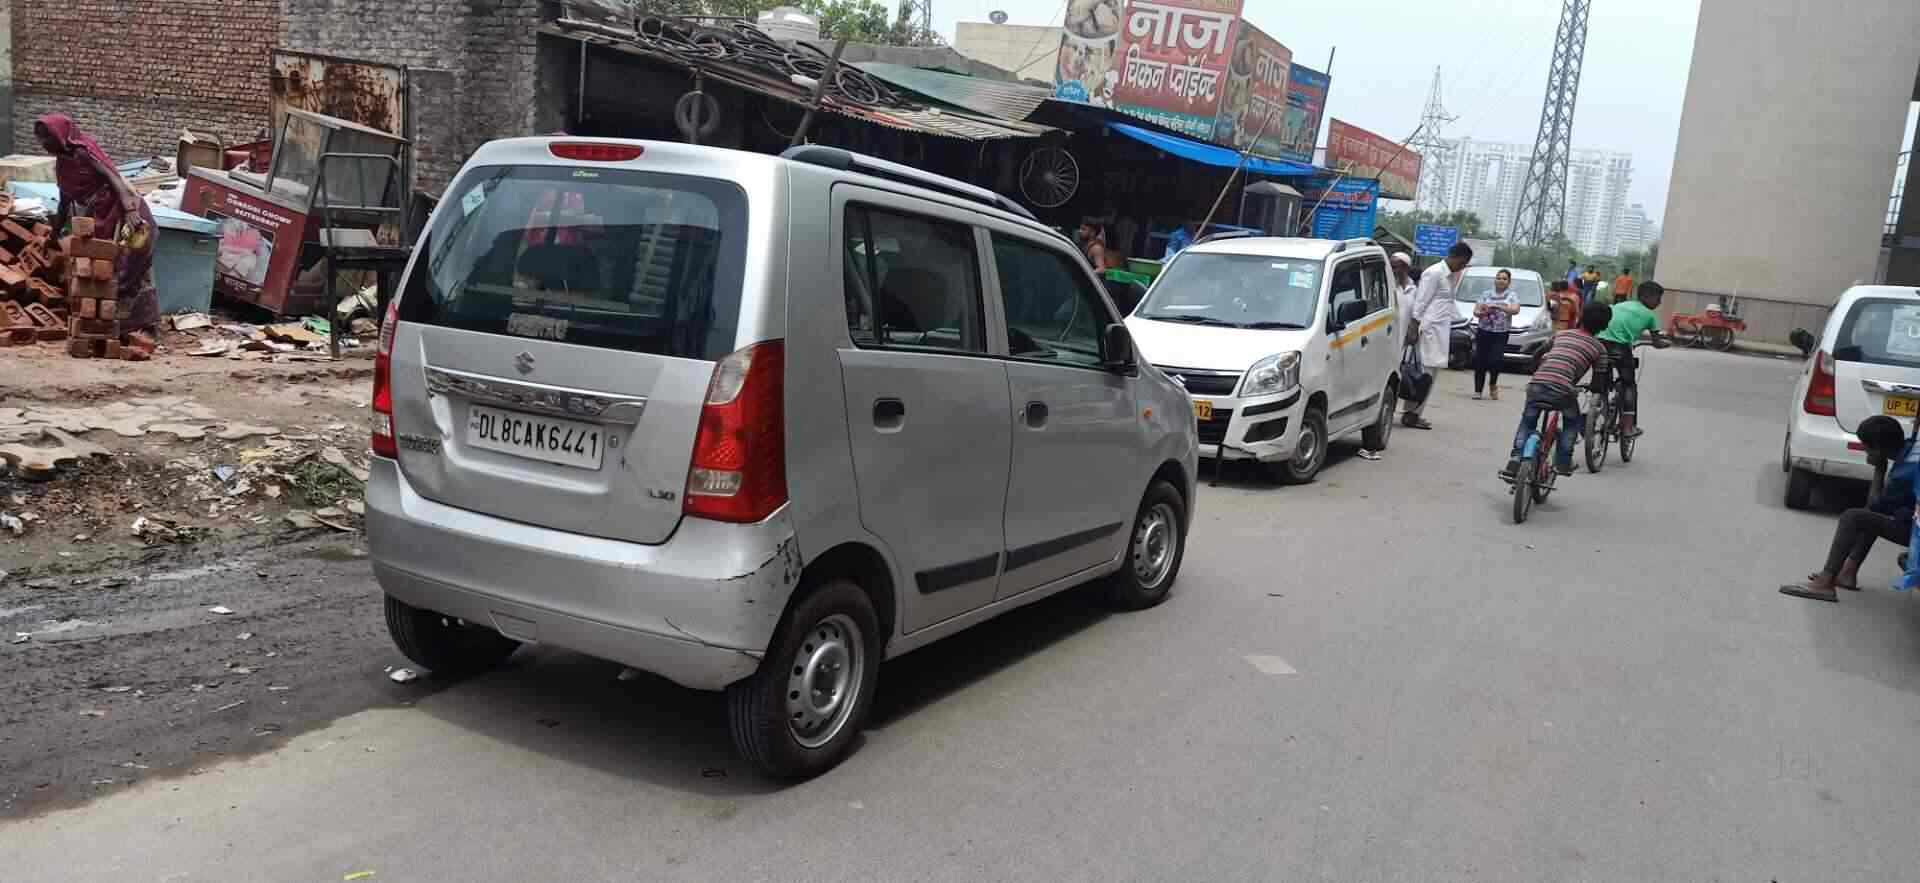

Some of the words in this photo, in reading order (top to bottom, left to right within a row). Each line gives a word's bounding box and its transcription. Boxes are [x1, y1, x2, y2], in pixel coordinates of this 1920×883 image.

[1129, 2, 1236, 54] नाज
[1122, 43, 1168, 92] चिकन
[1887, 399, 1902, 411] UP
[479, 413, 598, 459] DL8CAK6441
